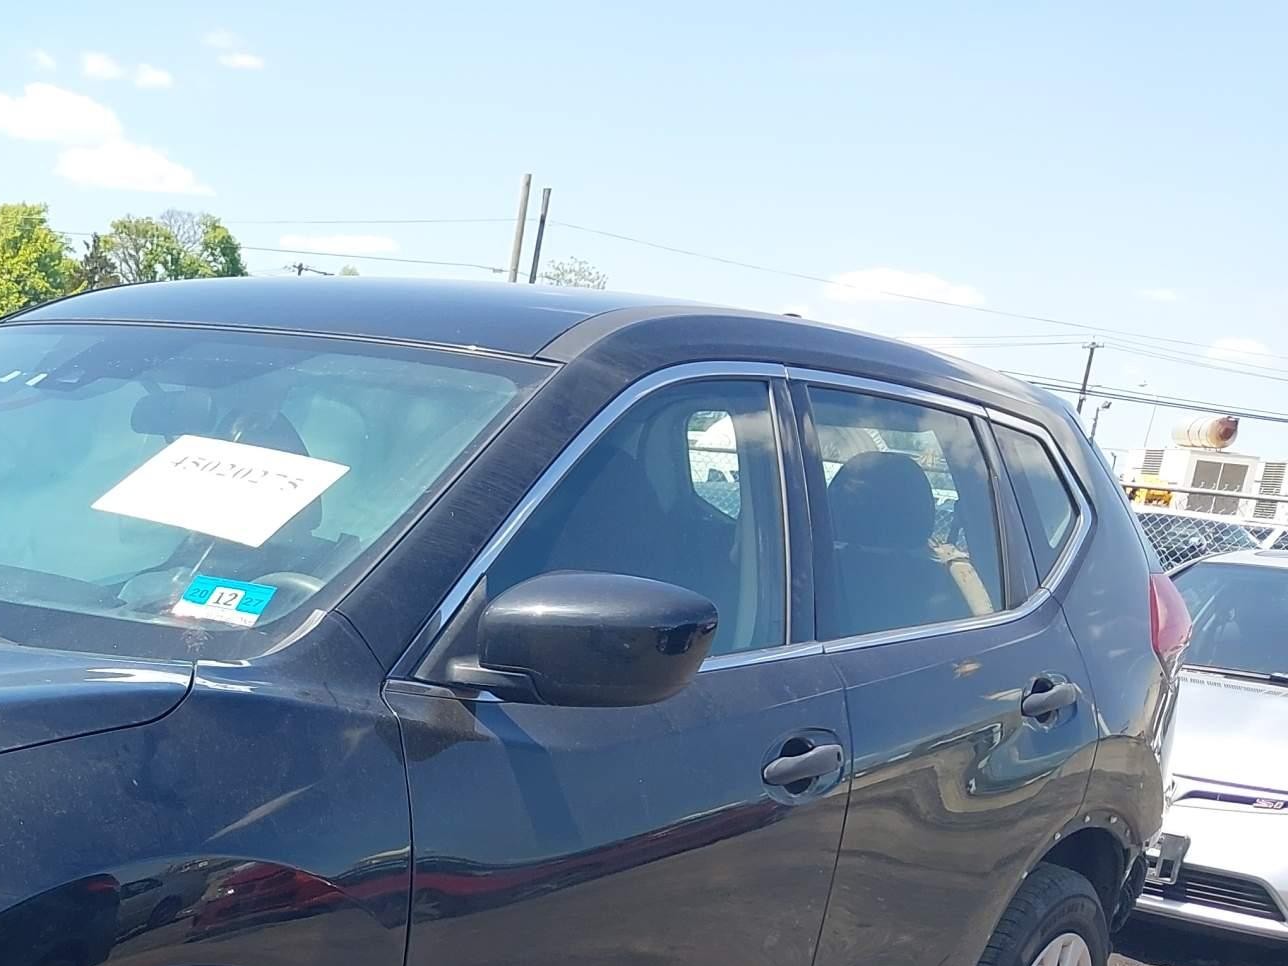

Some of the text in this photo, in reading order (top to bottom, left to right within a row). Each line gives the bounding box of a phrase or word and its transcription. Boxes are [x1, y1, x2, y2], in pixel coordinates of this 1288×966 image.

[189, 587, 265, 608] 20 12 27
